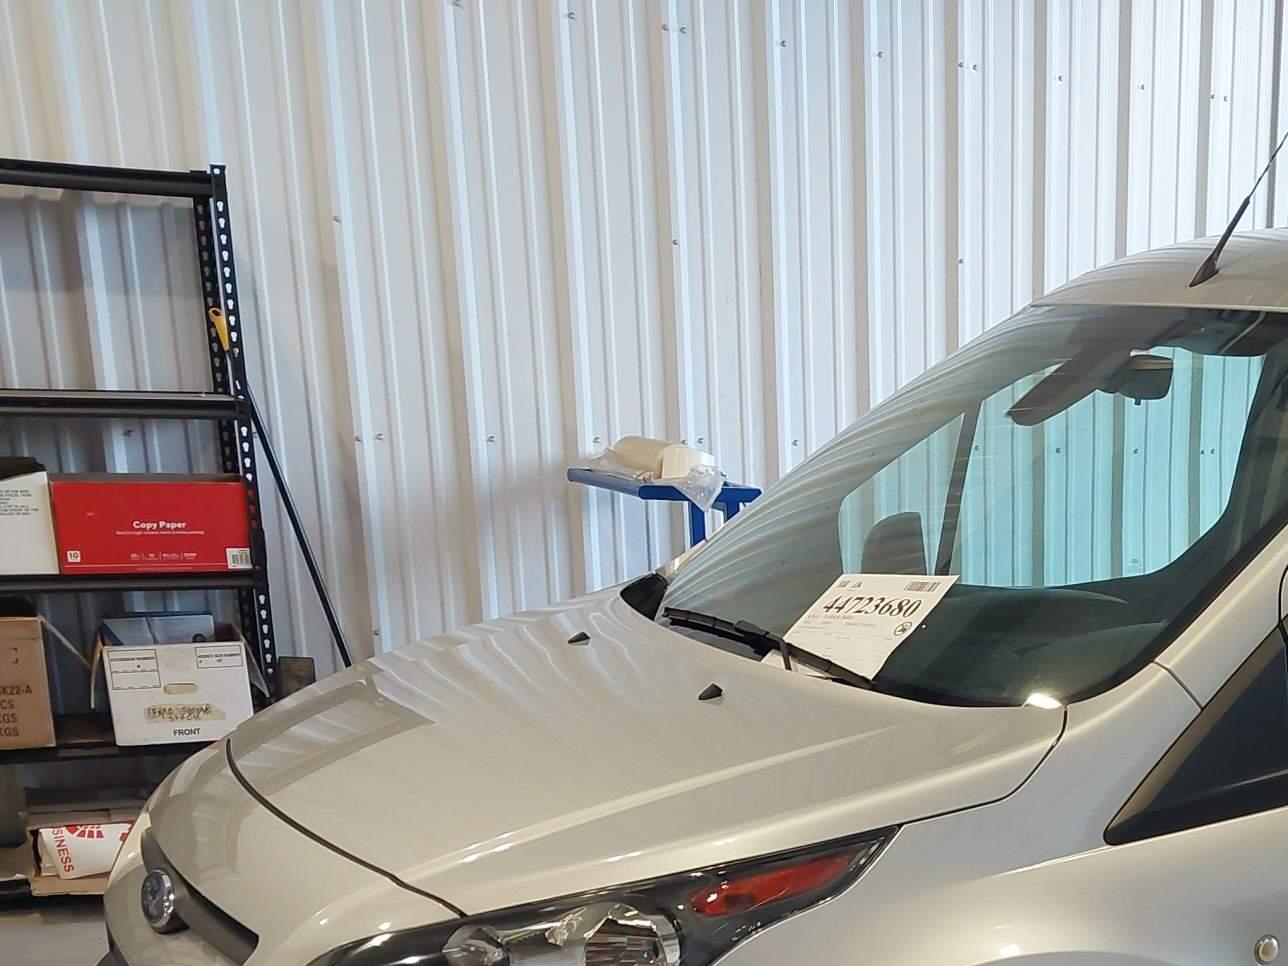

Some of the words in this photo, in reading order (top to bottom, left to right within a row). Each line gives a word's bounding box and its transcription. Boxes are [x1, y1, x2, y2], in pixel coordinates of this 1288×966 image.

[132, 521, 157, 530] Copy
[159, 521, 187, 530] Paper
[69, 552, 79, 560] 10
[823, 596, 922, 618] 44723680
[0, 684, 33, 696] K22-A
[173, 728, 201, 737] FRONT
[52, 828, 75, 873] SINESS
